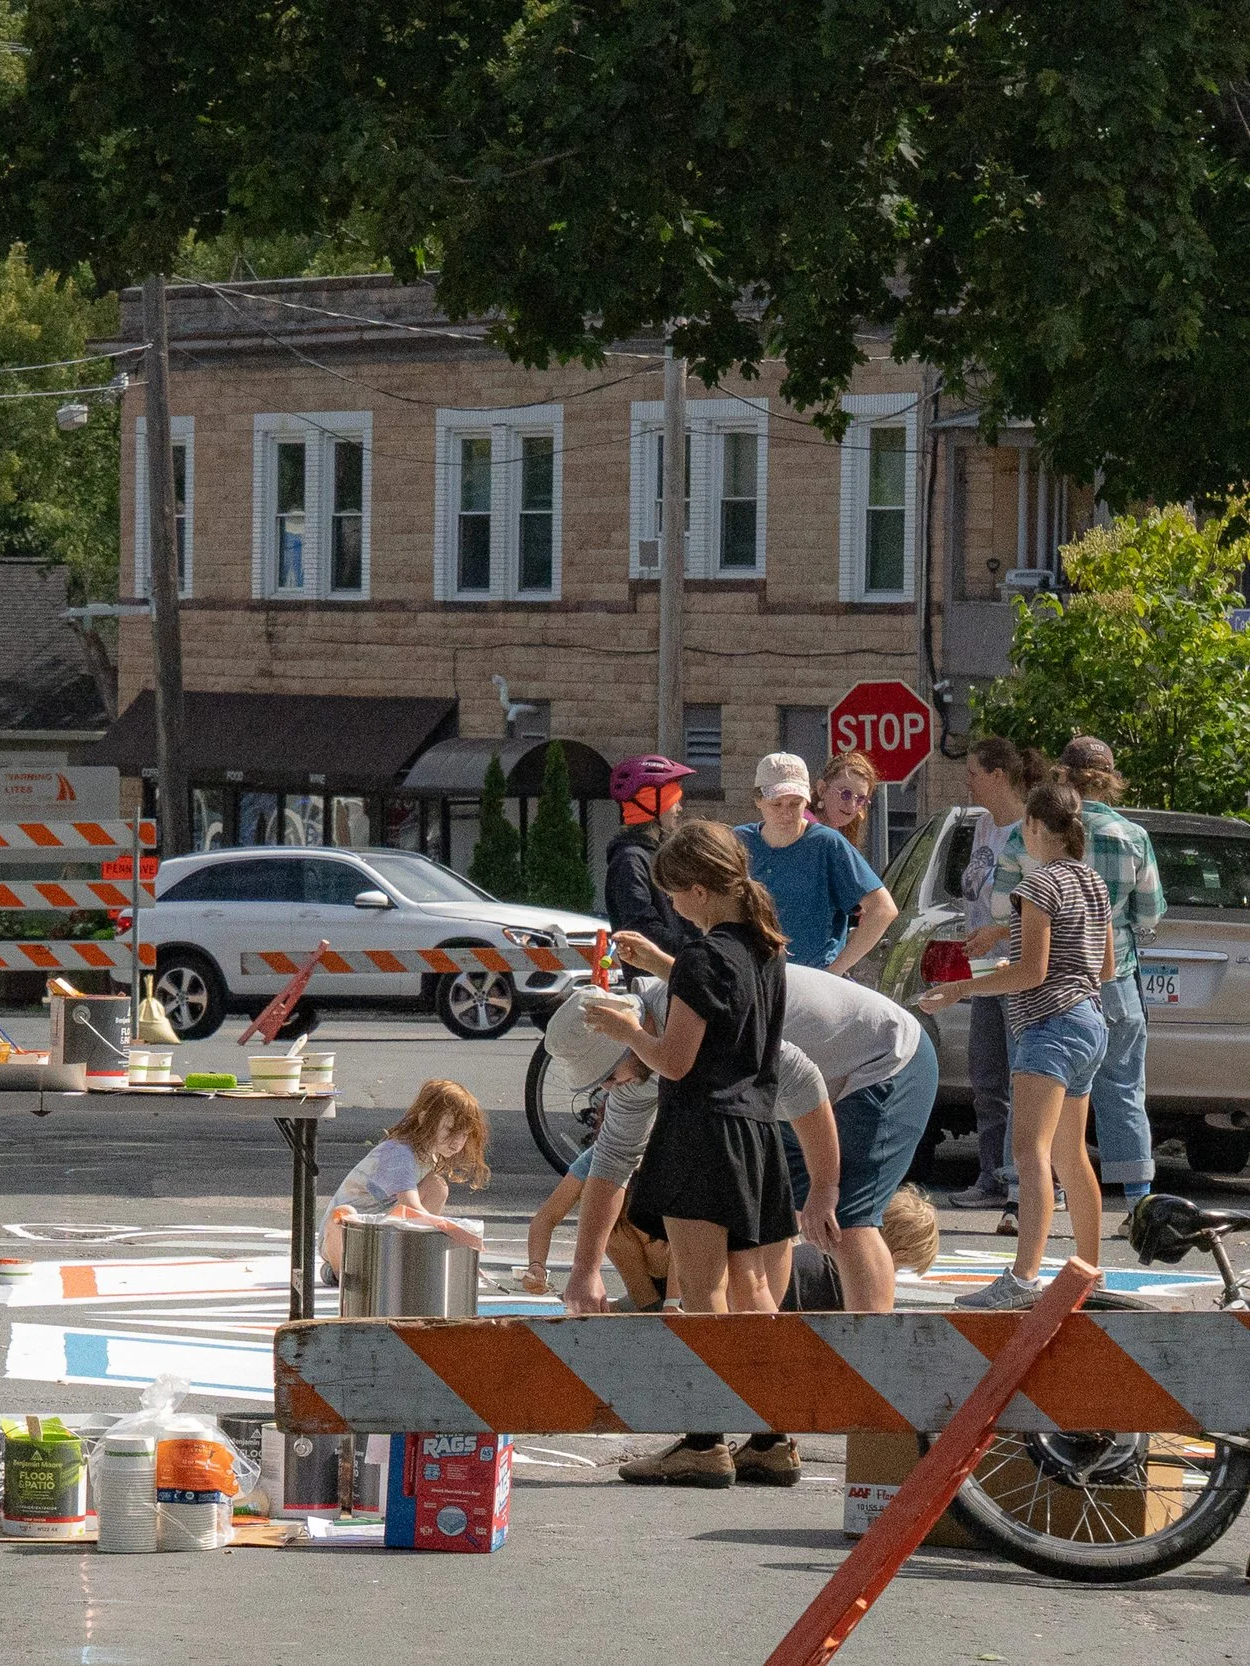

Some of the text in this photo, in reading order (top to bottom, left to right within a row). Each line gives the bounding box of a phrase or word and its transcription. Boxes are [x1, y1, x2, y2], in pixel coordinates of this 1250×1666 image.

[836, 713, 925, 752] STOP
[1146, 974, 1176, 994] 496
[423, 1436, 478, 1459] RAGS
[18, 1480, 56, 1490] &PATIO
[19, 1471, 55, 1481] FLOOR
